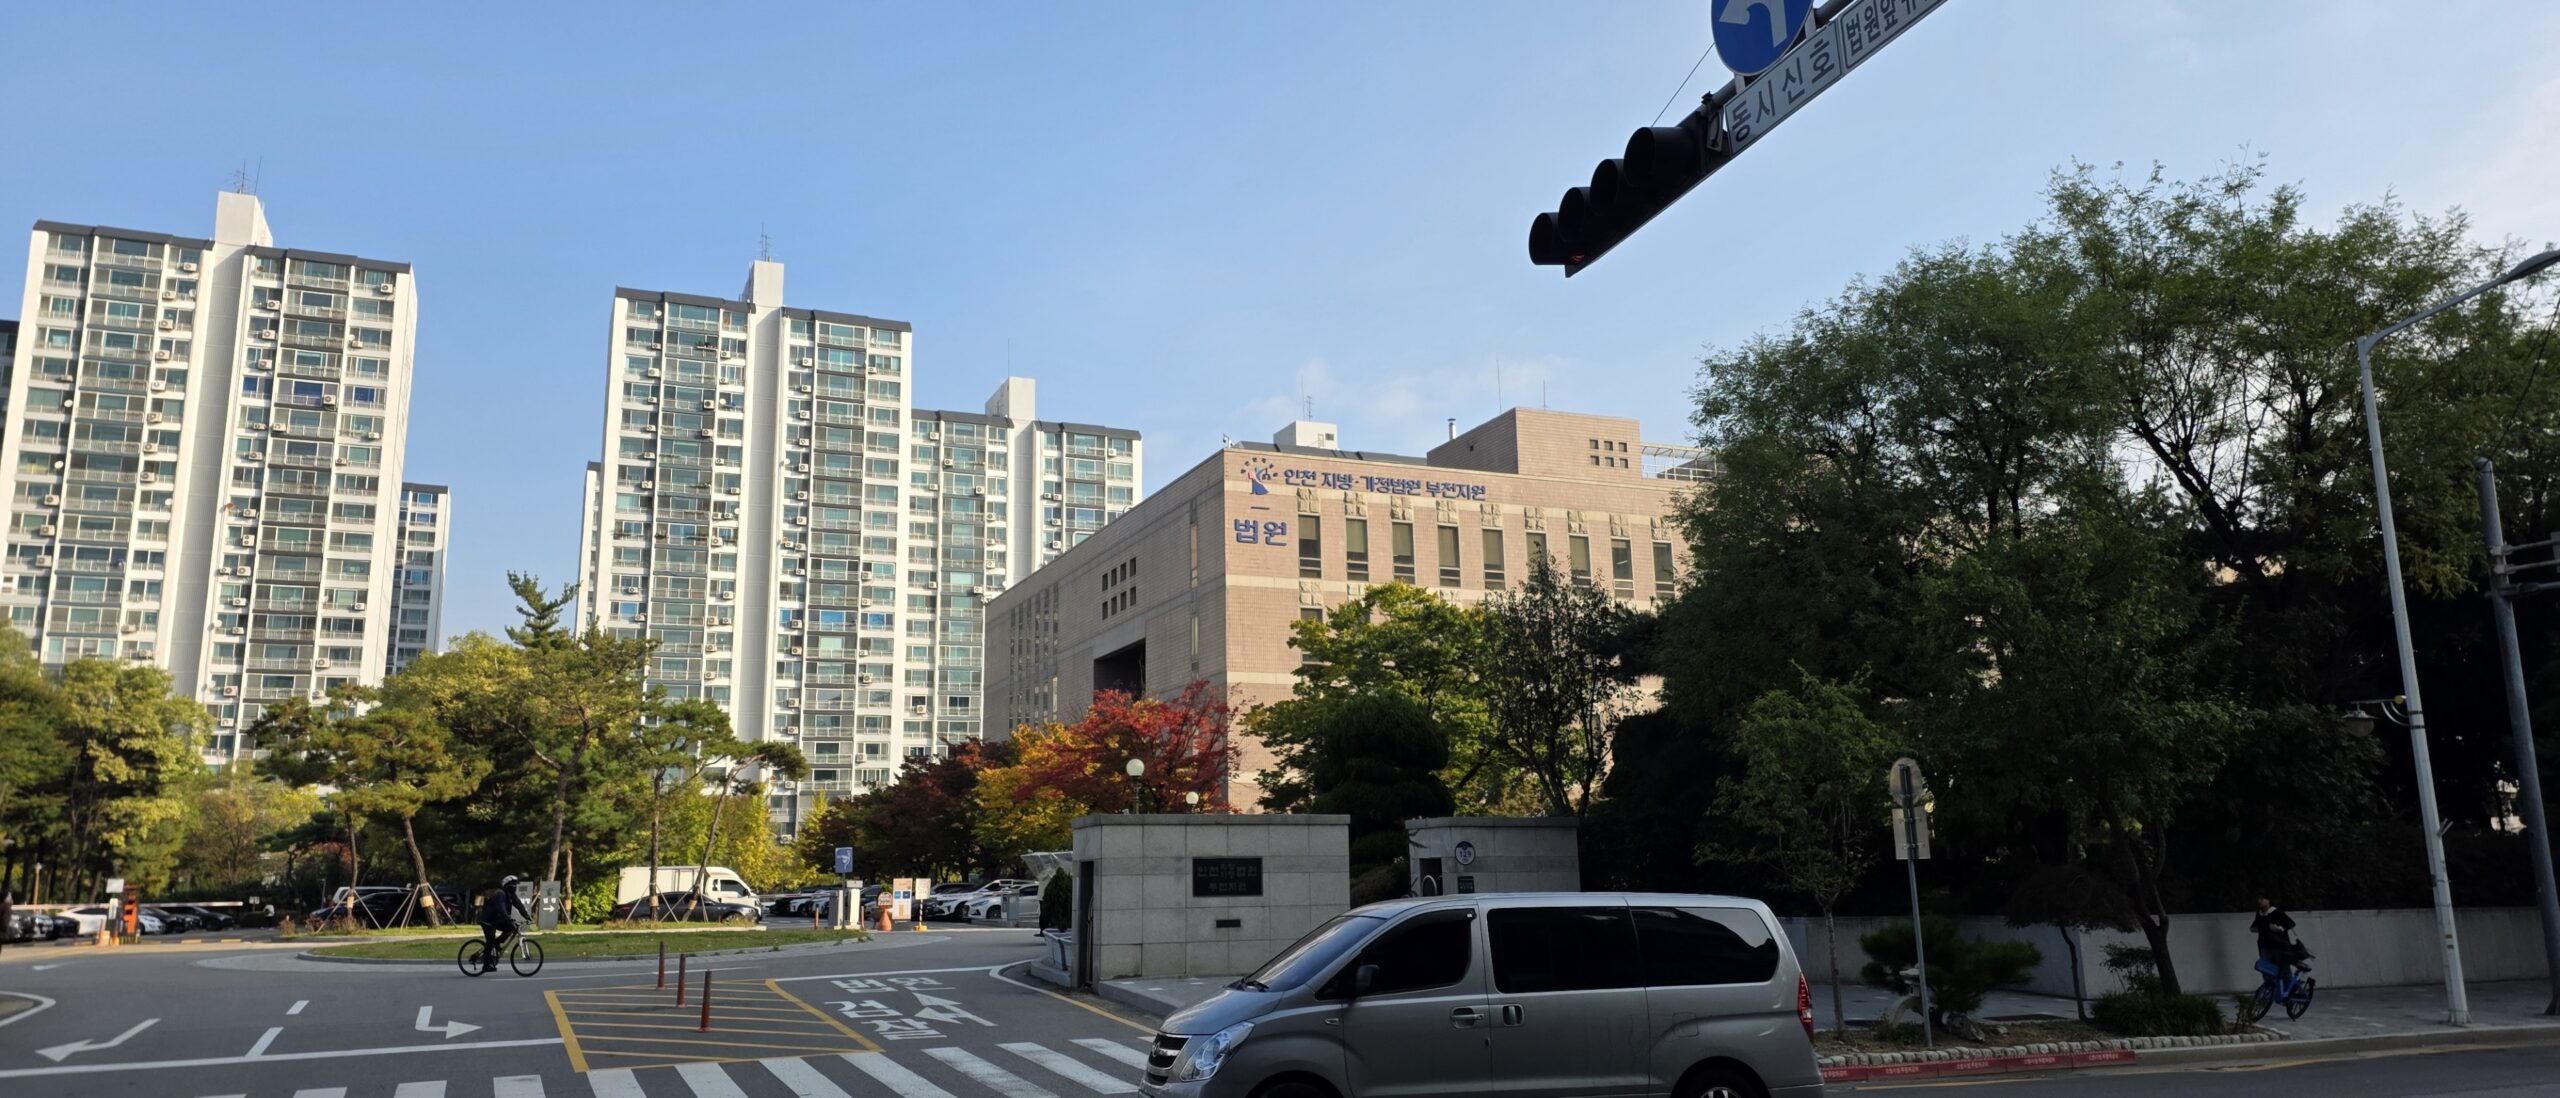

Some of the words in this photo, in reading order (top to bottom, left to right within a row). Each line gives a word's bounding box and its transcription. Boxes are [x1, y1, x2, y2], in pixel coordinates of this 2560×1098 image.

[1732, 38, 1835, 143] 동시신호
[1284, 468, 1317, 488] 인천
[1426, 480, 1486, 501] 부천지원
[1234, 518, 1288, 547] 법원
[830, 977, 956, 994] 법원
